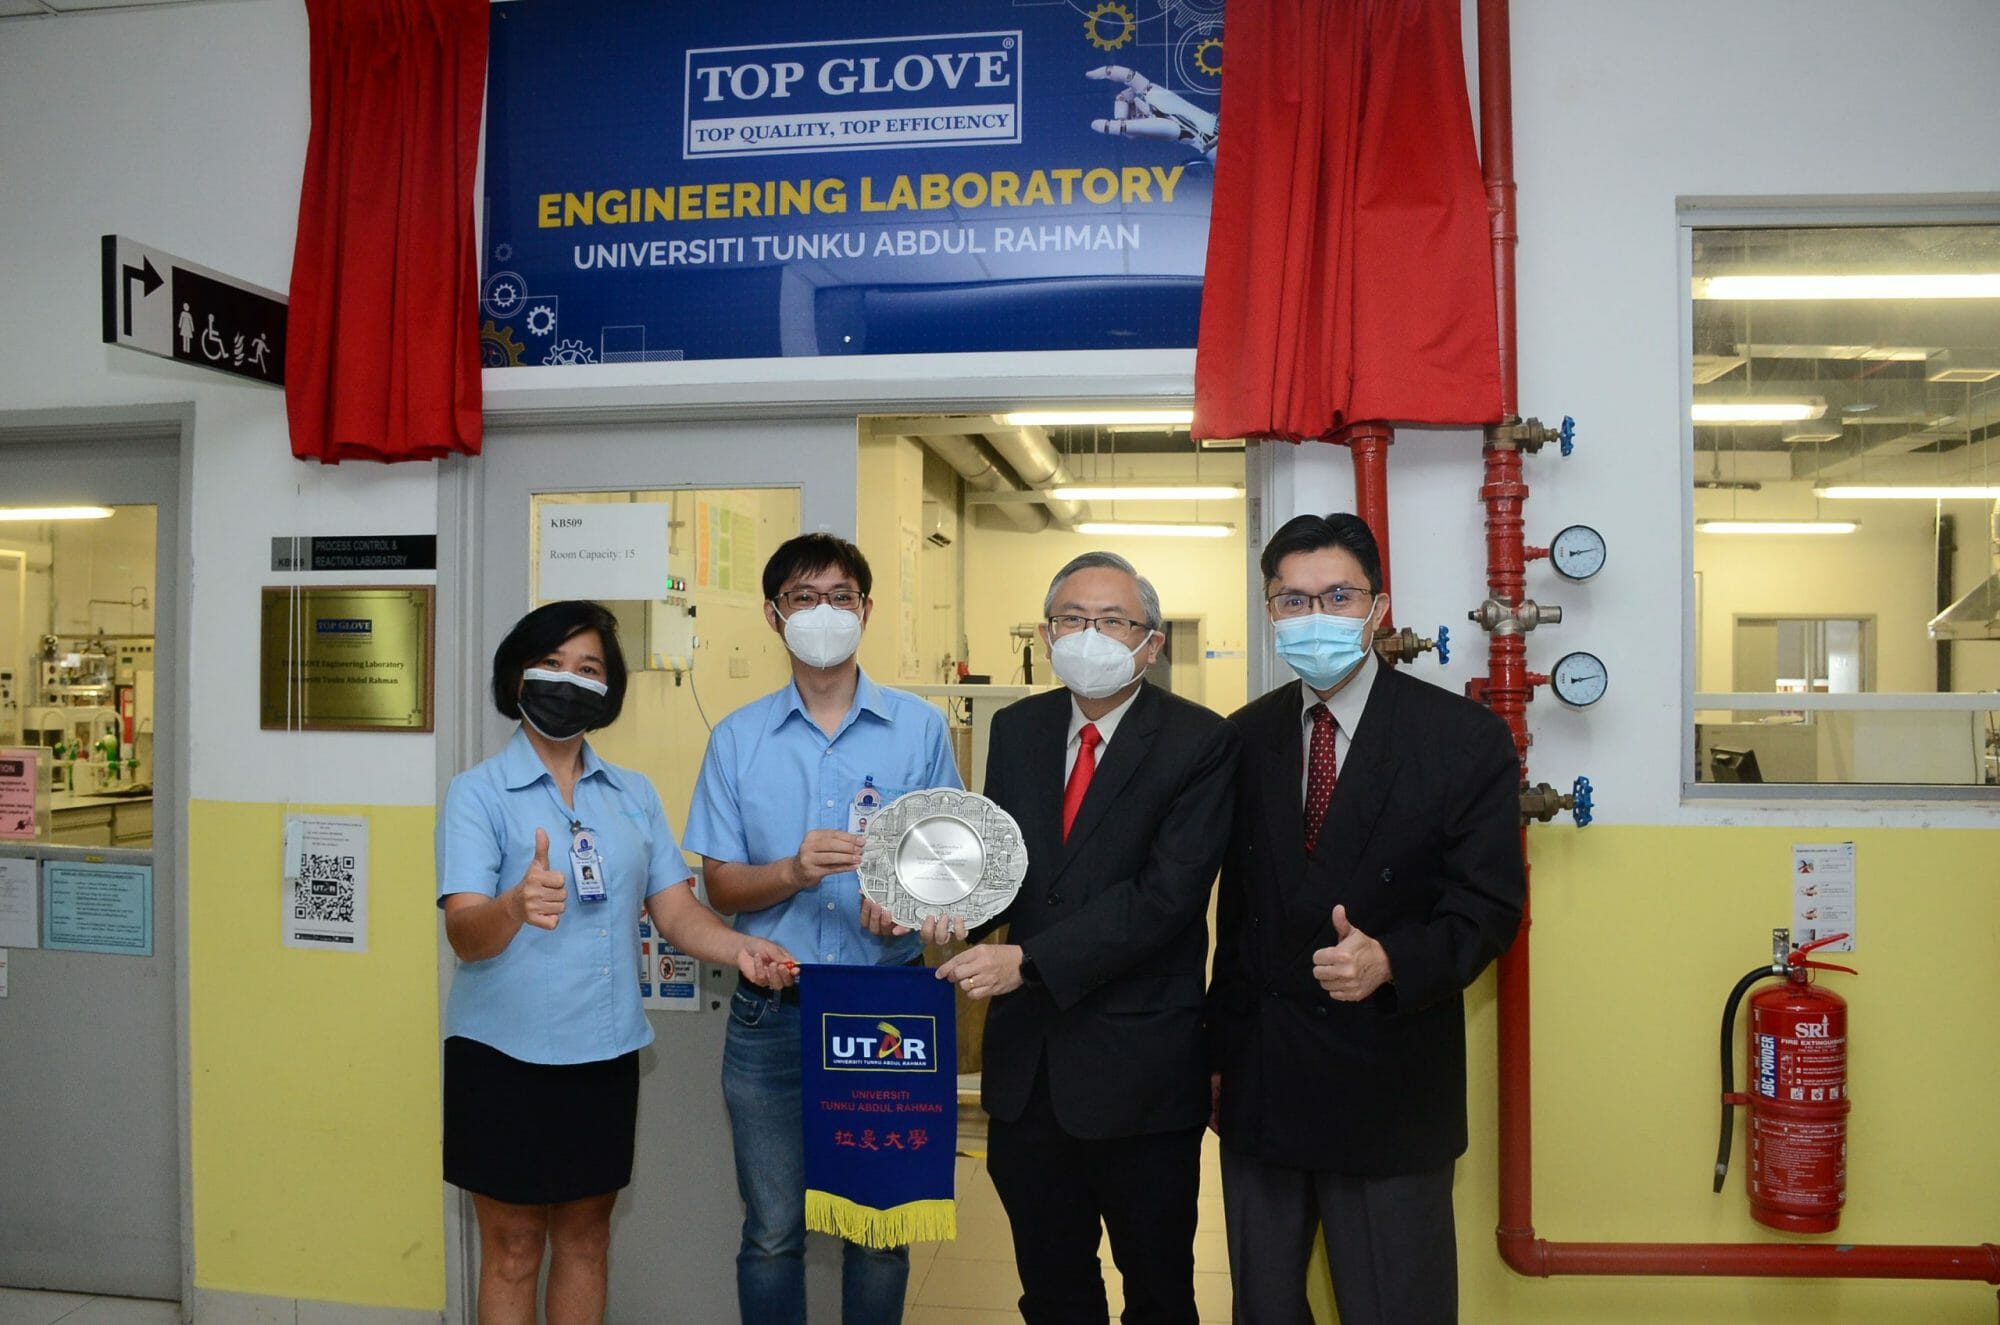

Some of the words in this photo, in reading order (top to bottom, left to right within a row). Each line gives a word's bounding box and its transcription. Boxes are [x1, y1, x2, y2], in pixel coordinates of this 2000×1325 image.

[696, 62, 805, 102] TOP
[696, 127, 735, 143] TOP
[740, 121, 835, 144] QUALITY,
[840, 119, 881, 135] TOP
[886, 113, 1009, 133] EFFICIENCY
[538, 177, 847, 228] ENGINEERING
[860, 165, 1185, 212] LABORATORY
[574, 237, 744, 270] UNIVERSITI
[752, 231, 866, 263] TUNKU
[873, 229, 986, 257] ABDUL
[994, 223, 1140, 252] RAHMAN
[551, 519, 582, 528] KB509
[315, 541, 351, 551] PROCESS
[353, 540, 390, 551] CONTROL
[550, 550, 577, 559] Room
[625, 549, 635, 559] 15
[315, 556, 353, 567] REACTION
[355, 555, 408, 566] LABORATORY
[319, 622, 337, 631] TOP
[339, 622, 371, 631] GLOVE
[365, 660, 404, 671] Laboratory
[368, 677, 399, 685] Rahman
[832, 1028, 926, 1060] UTAR
[1761, 1036, 1775, 1076] POWDER
[1761, 1077, 1775, 1098] ABC
[852, 1089, 910, 1100] UNIVERSITI
[820, 1101, 856, 1111] TUNKU
[857, 1102, 893, 1113] ABDUL
[896, 1103, 943, 1113] RAHMAN
[834, 1129, 928, 1151] 拉曼大學
